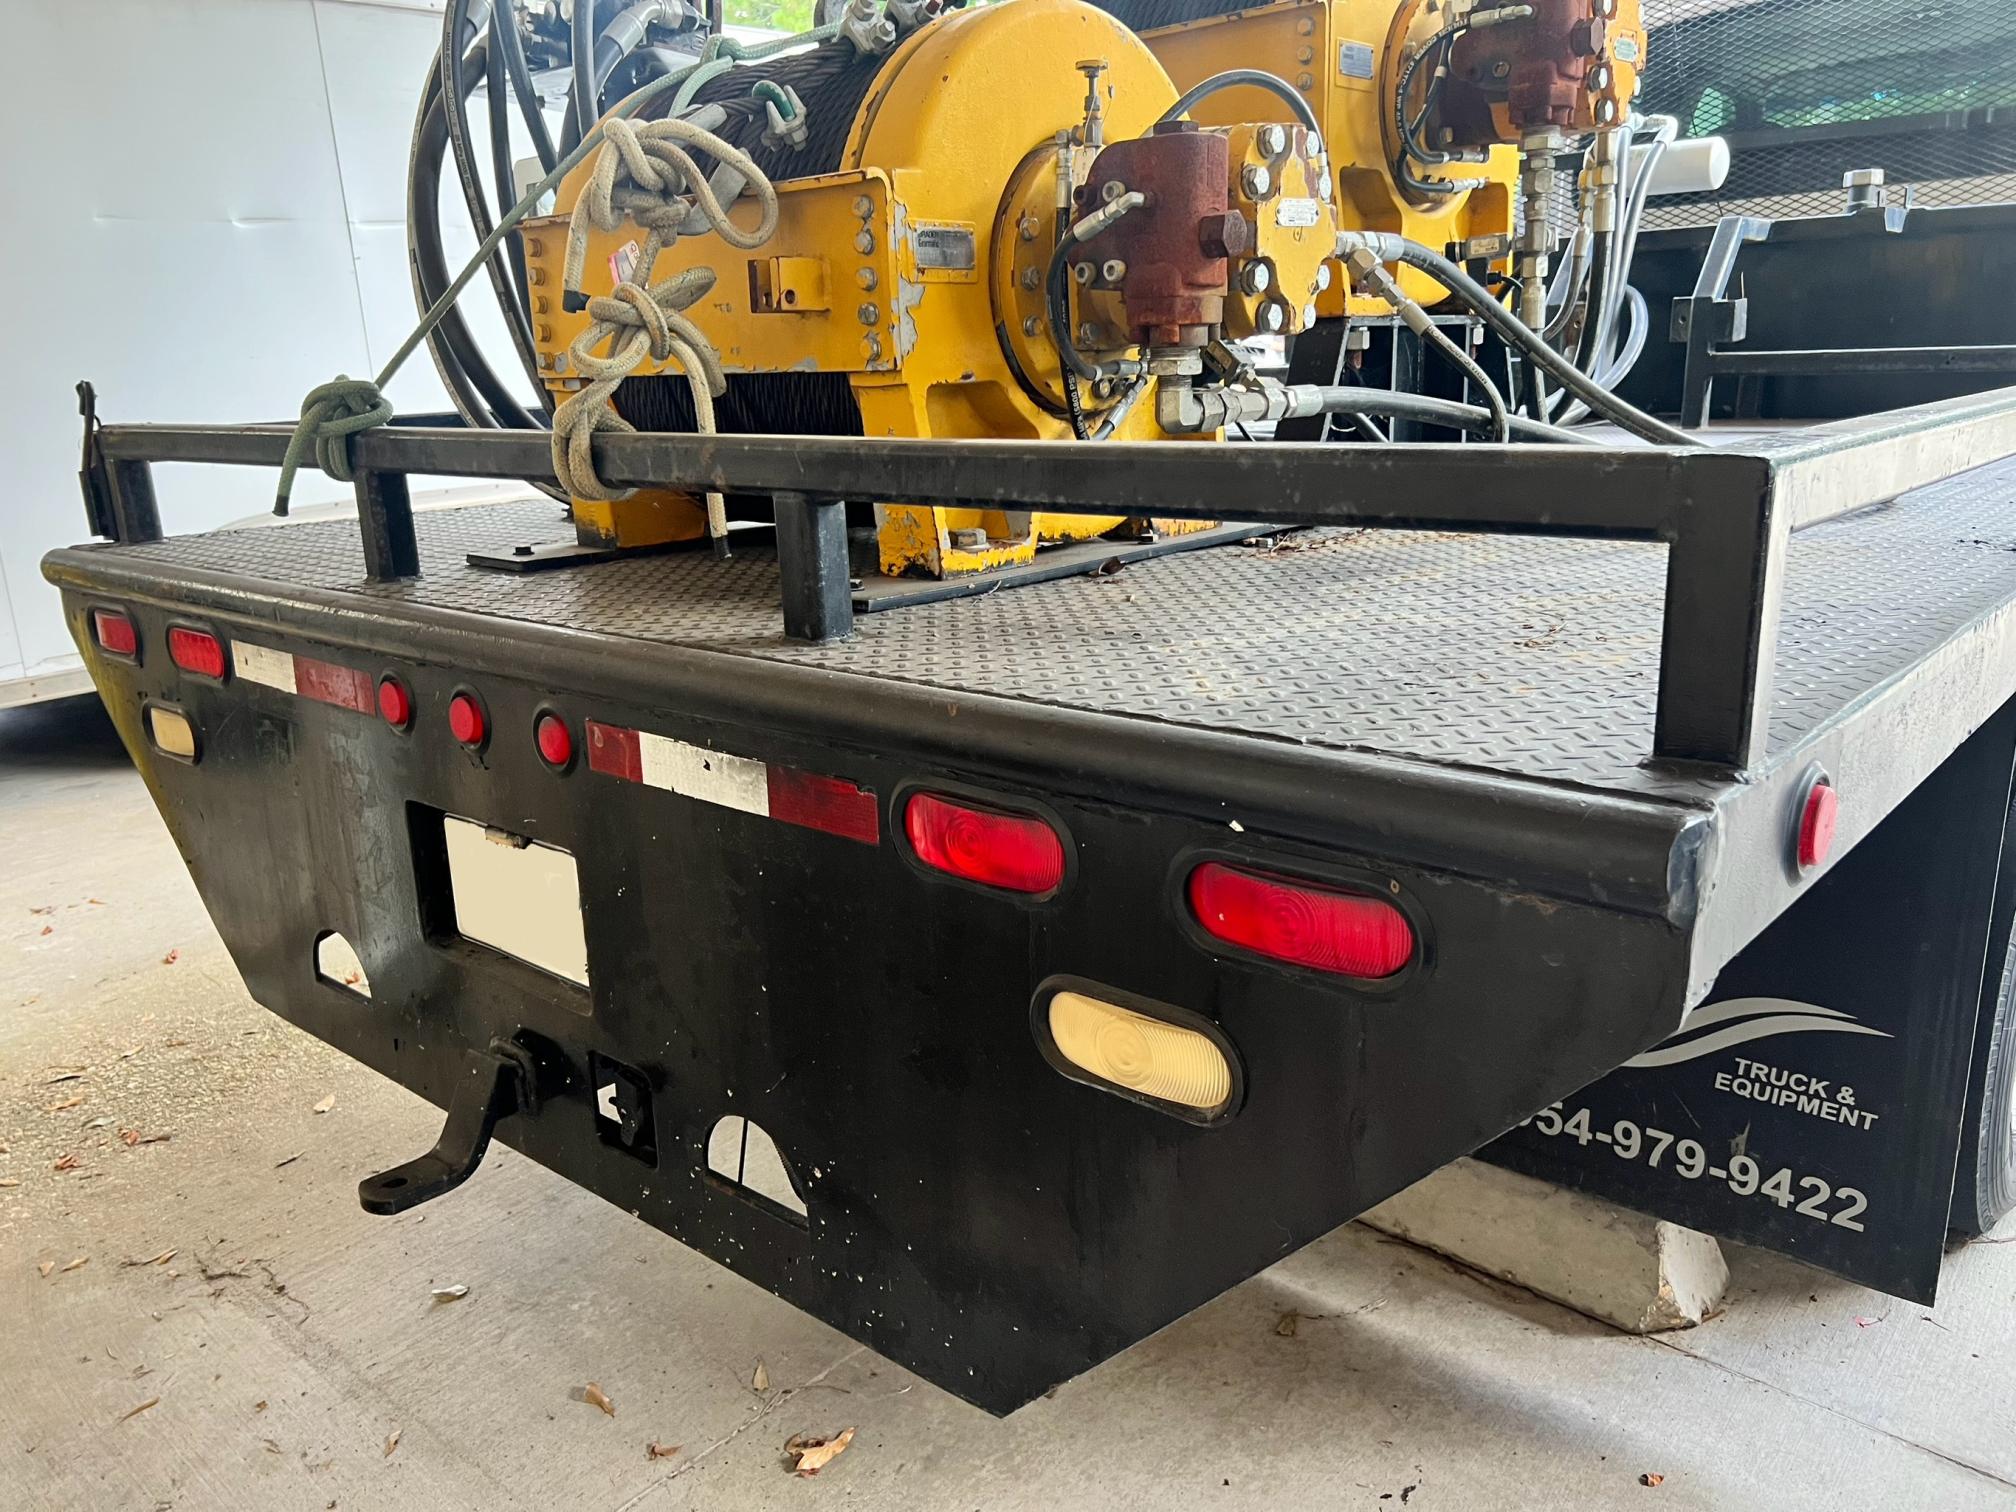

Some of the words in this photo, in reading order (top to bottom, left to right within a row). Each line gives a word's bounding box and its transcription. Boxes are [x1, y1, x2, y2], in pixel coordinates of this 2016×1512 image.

[1413, 35, 1438, 60] COVER
[1714, 1072, 1879, 1130] EQUIPMENT
[1735, 1057, 1830, 1099] TRUCK
[1836, 1086, 1856, 1106] &
[1519, 1101, 1868, 1232] 54-979-9422
